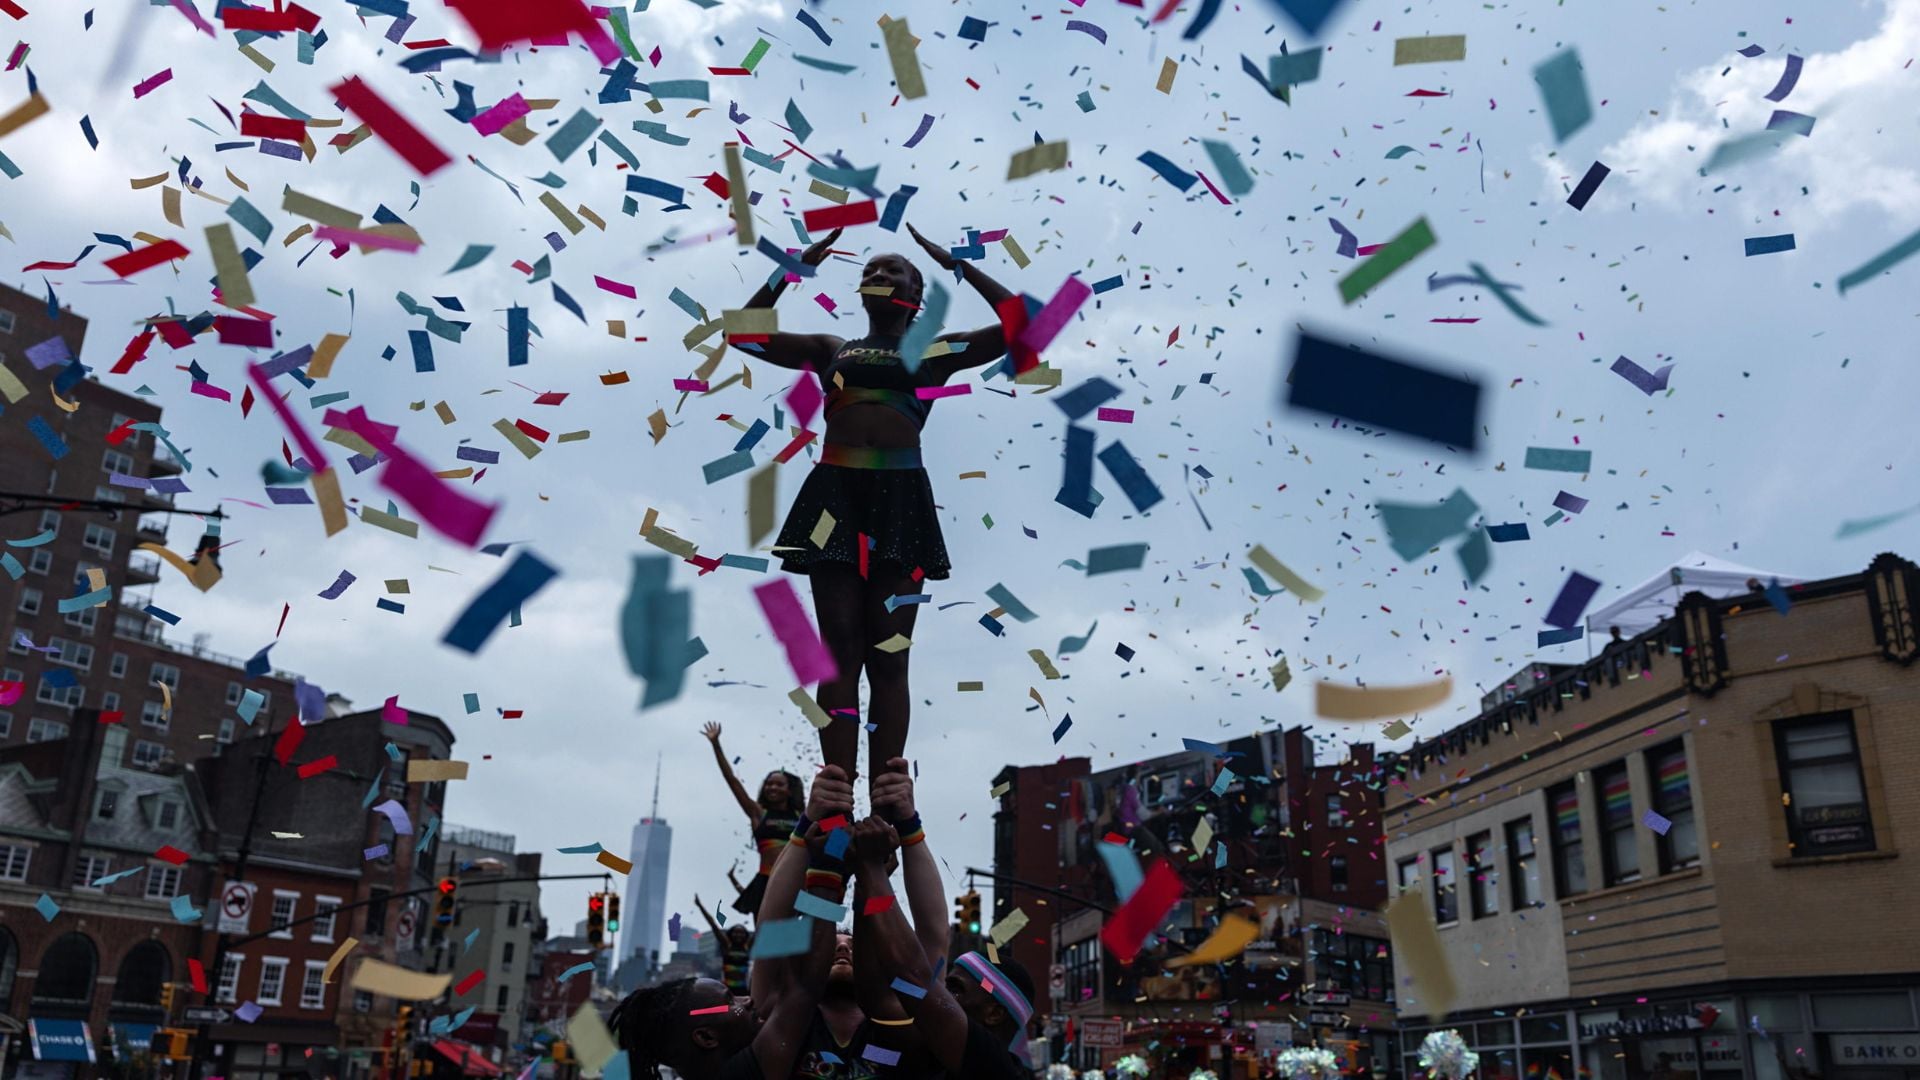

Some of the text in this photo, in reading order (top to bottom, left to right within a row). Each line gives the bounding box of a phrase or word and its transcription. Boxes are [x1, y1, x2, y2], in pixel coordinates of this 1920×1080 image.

[838, 347, 903, 359] GOTHA
[39, 1035, 74, 1045] CHASE
[1844, 1045, 1920, 1058] BANK O
